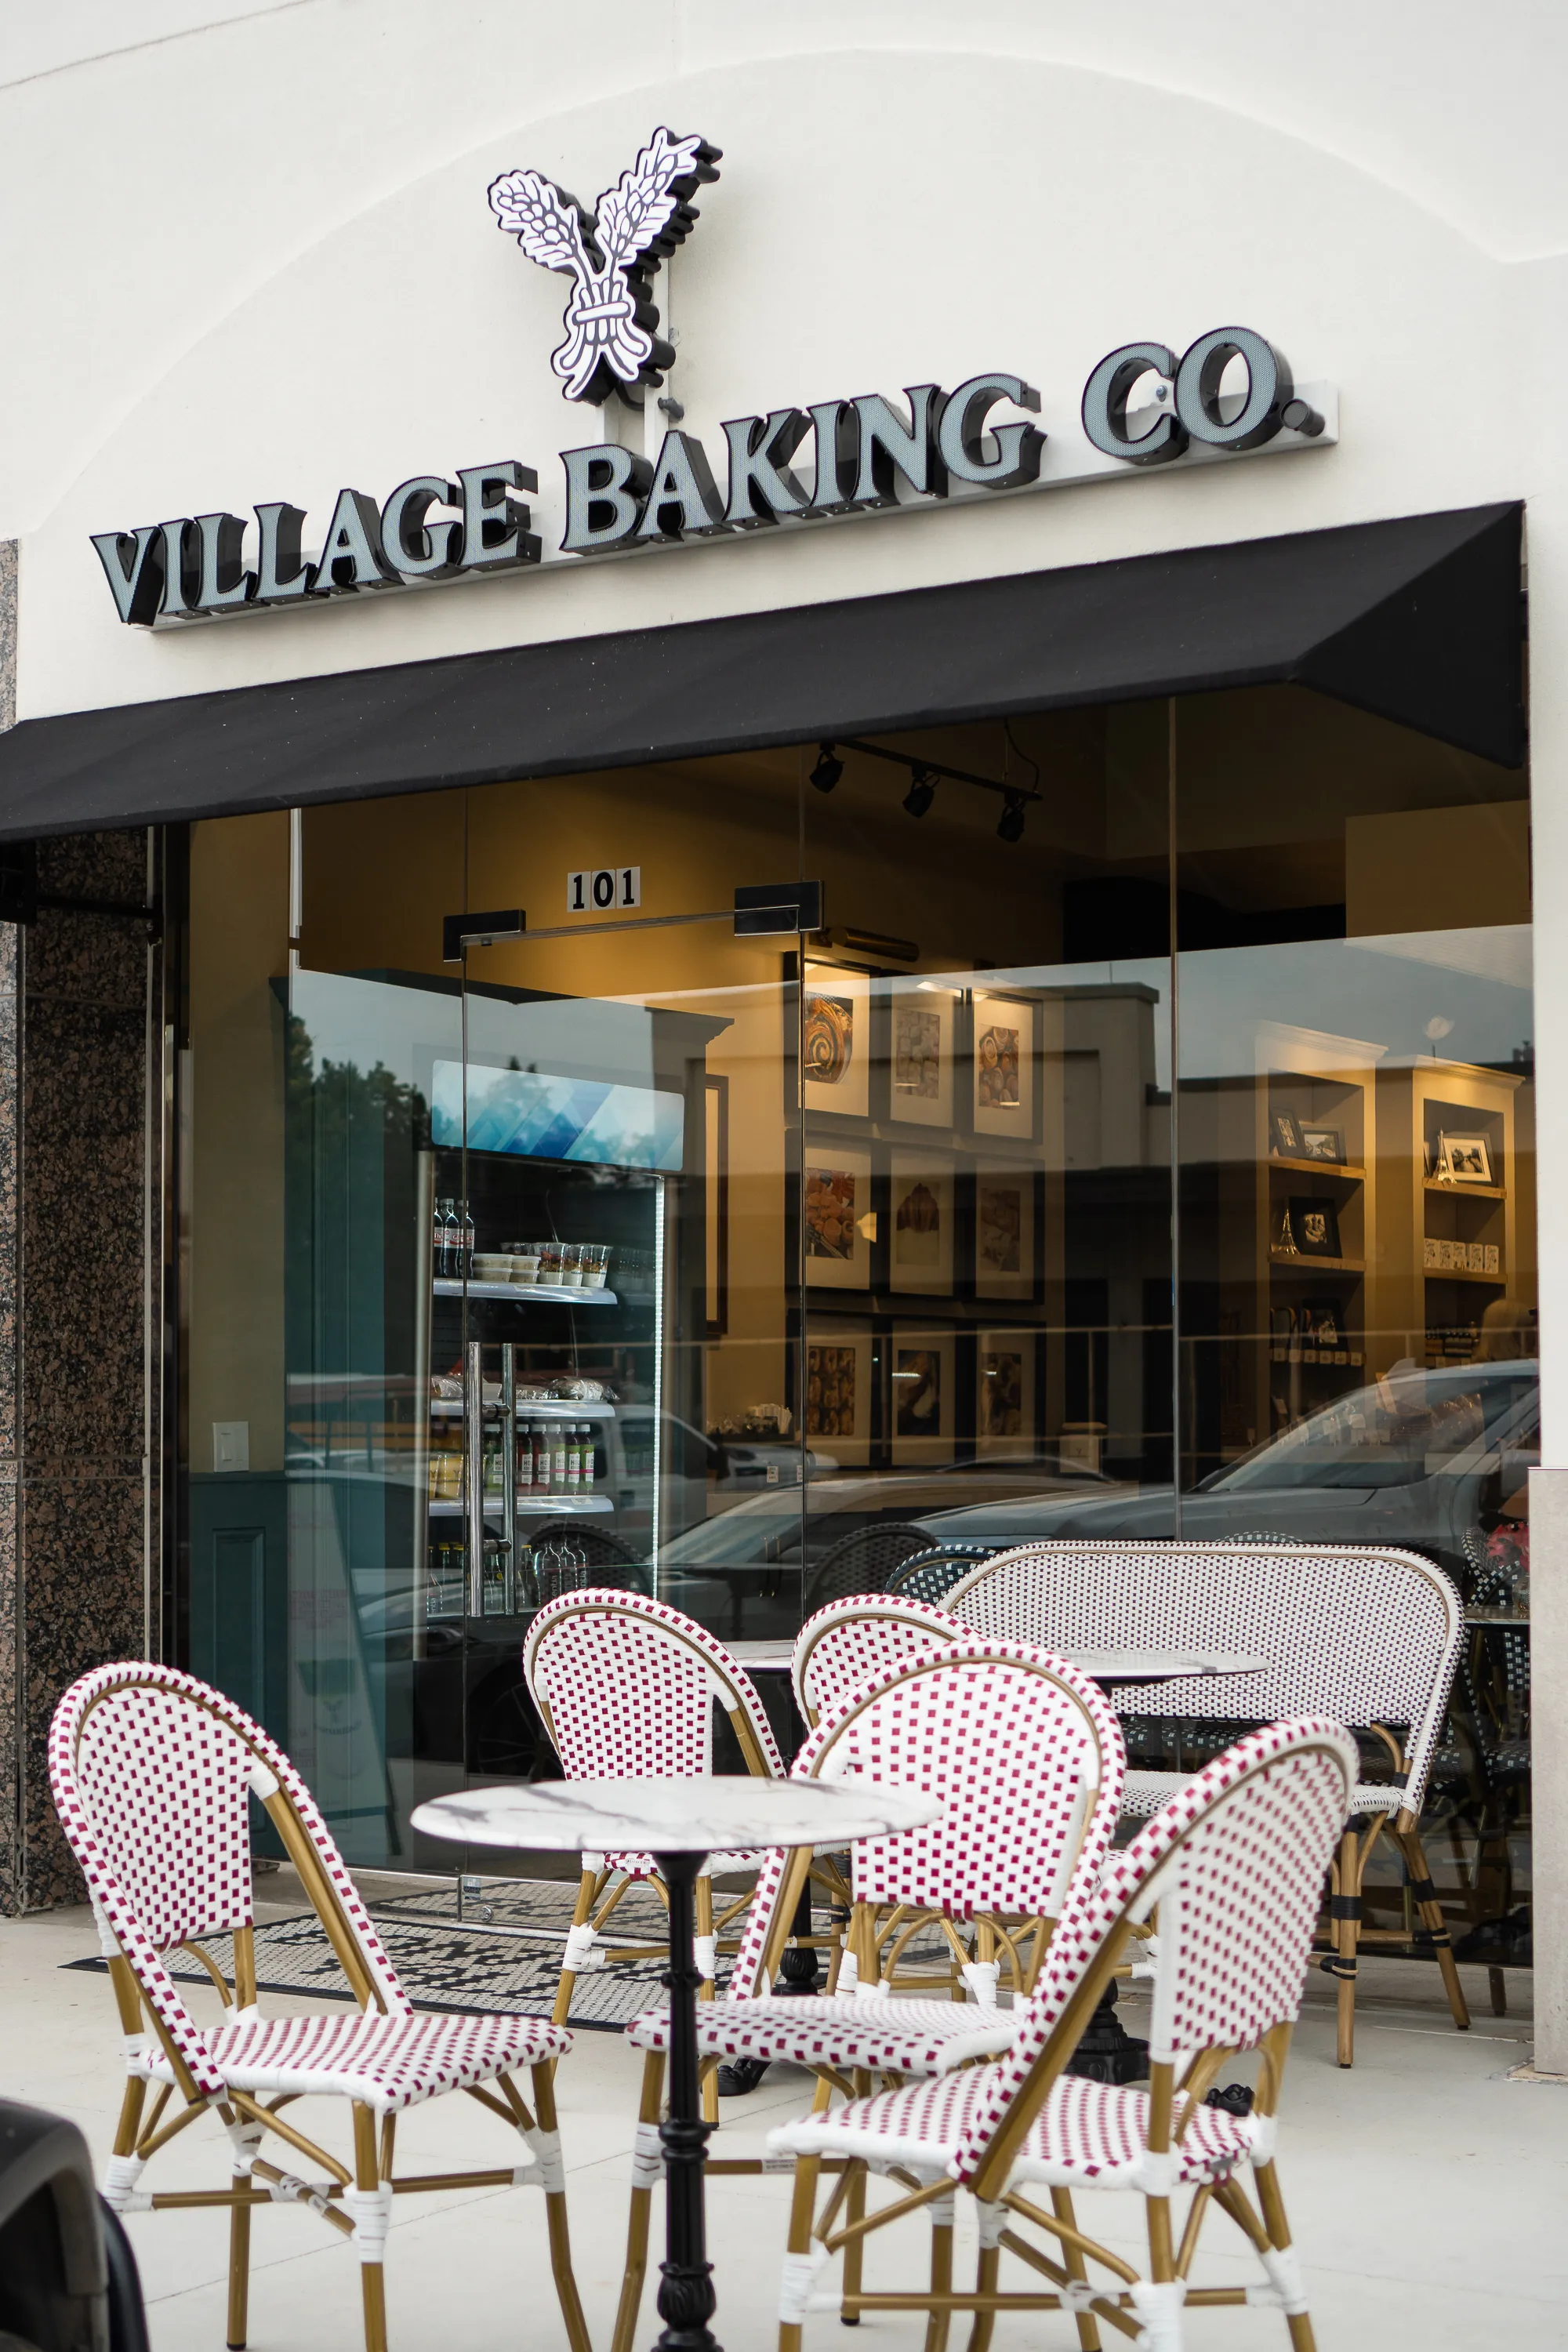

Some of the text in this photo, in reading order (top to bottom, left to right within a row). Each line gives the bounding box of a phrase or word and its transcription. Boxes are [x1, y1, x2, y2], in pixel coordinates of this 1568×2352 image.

[89, 325, 1322, 625] VILLAGE BAKING CO.
[573, 869, 634, 909] 101
